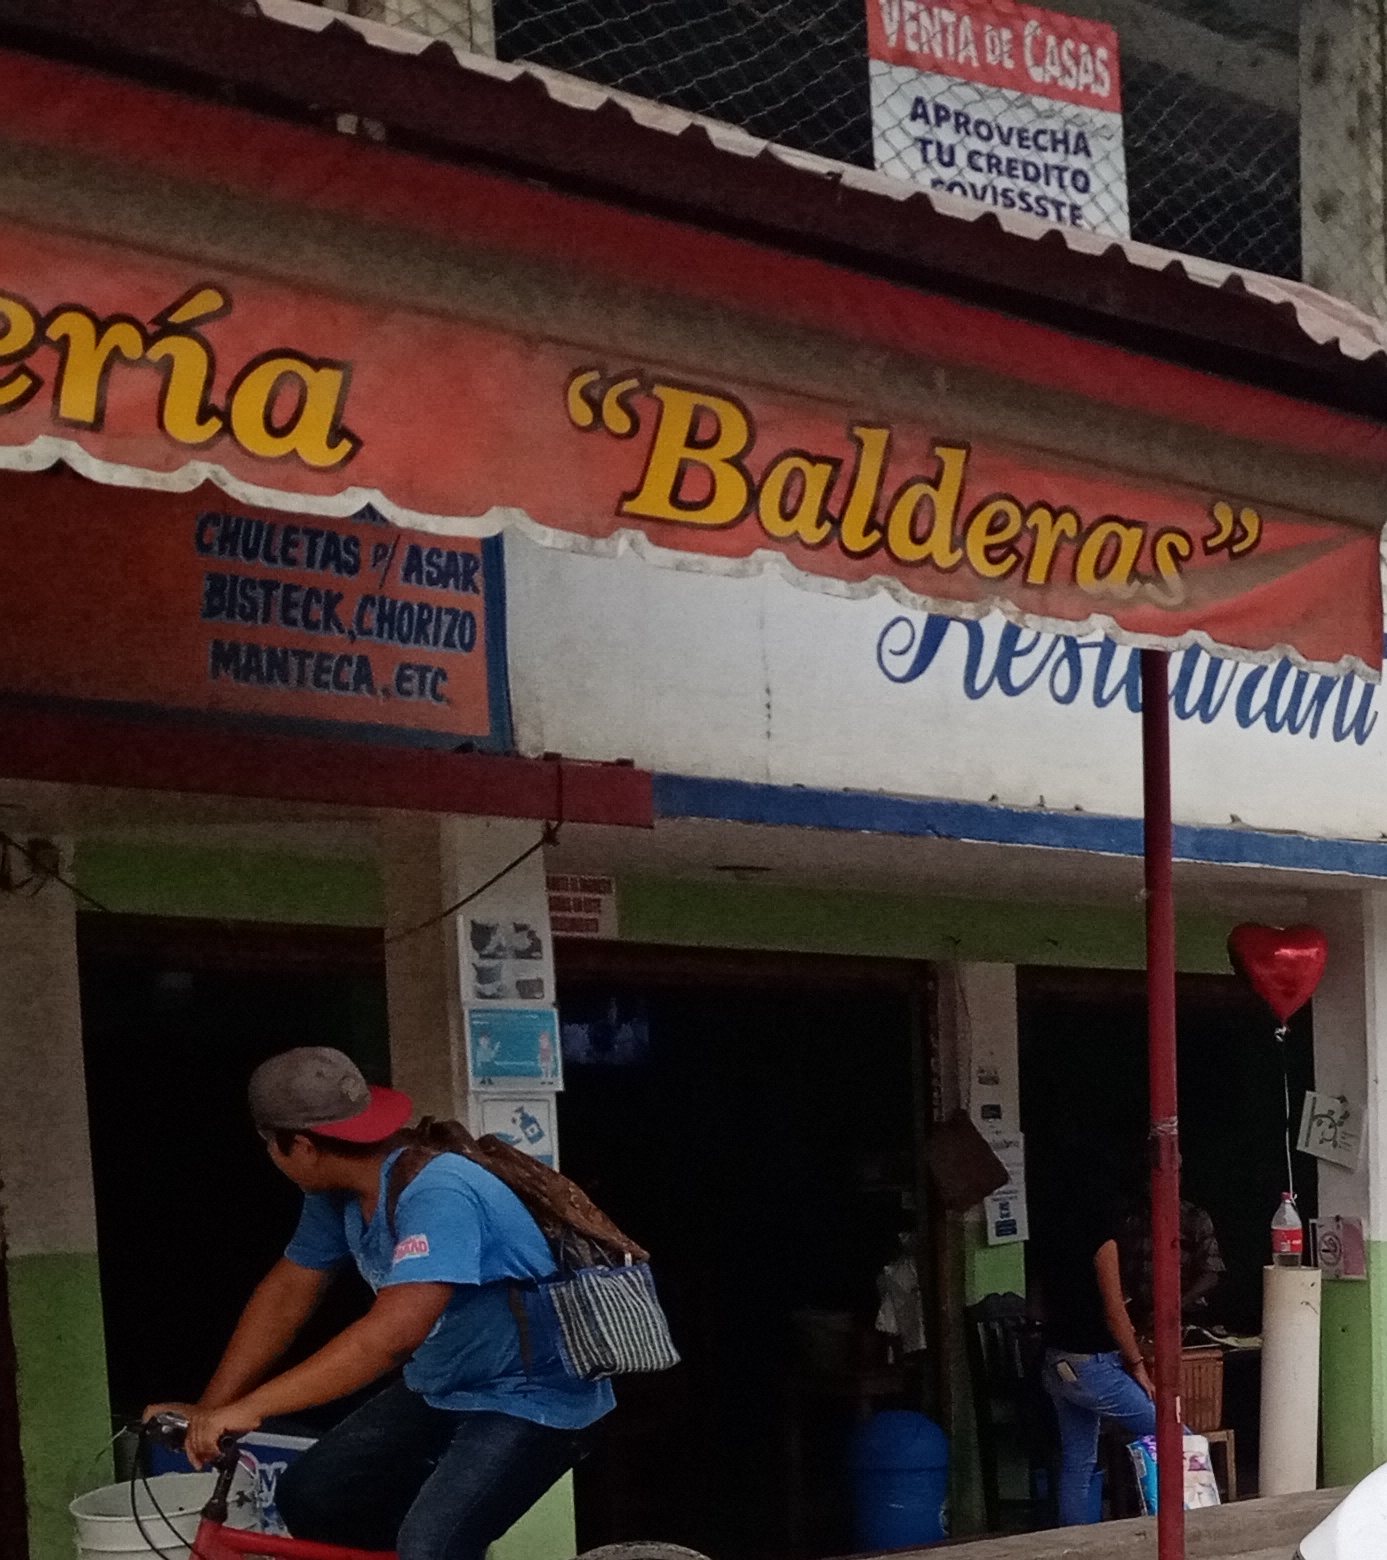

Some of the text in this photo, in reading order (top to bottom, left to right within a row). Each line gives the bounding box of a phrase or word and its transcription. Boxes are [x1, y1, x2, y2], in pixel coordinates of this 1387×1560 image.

[880, 0, 1111, 97] VENTA DE CASAS
[910, 96, 1092, 158] APROVECHA
[915, 137, 1091, 194] TU CREDITO
[195, 513, 361, 578] CHULETAS
[401, 542, 483, 595] ASAR
